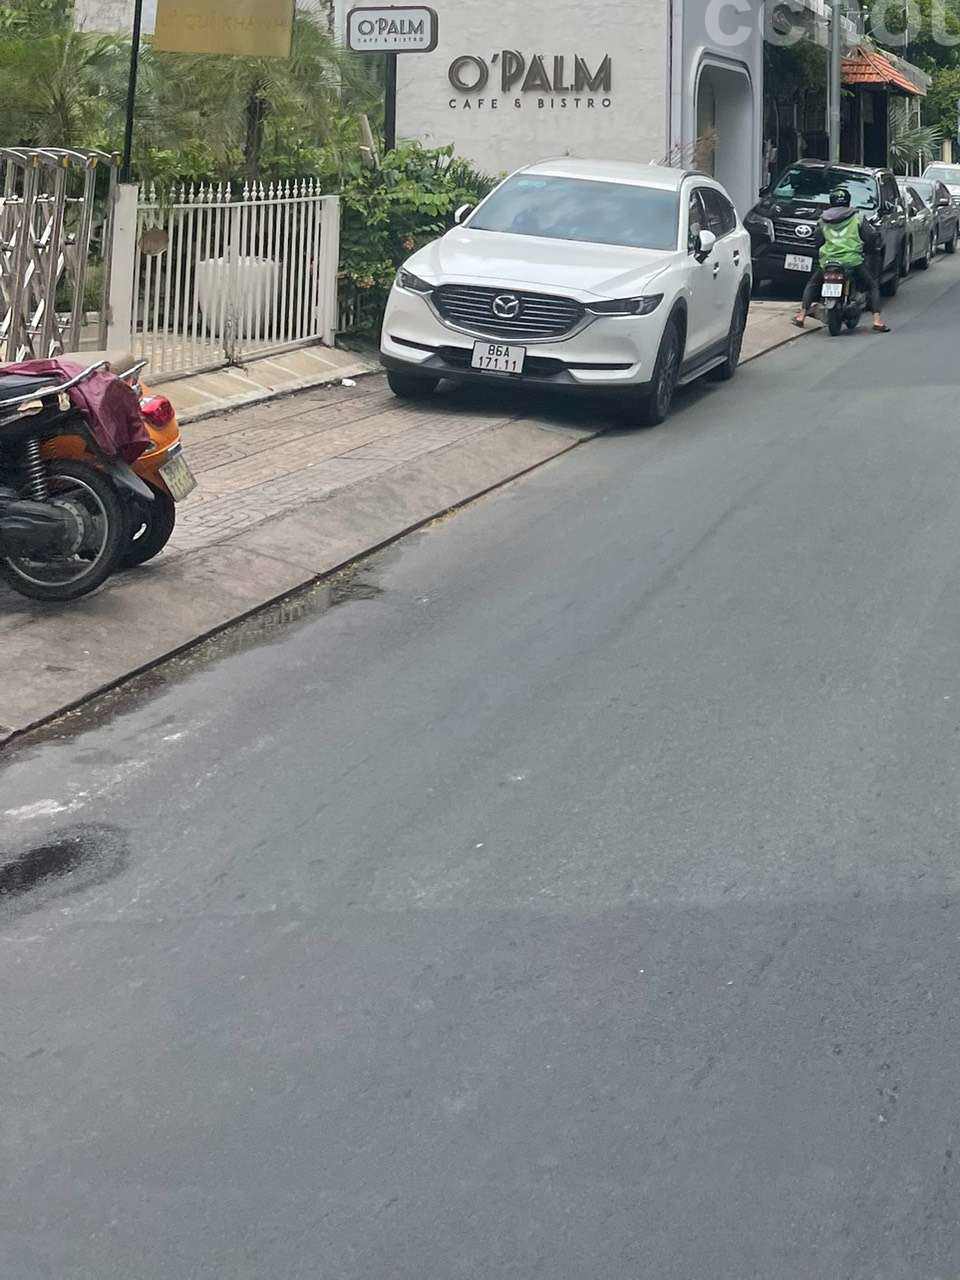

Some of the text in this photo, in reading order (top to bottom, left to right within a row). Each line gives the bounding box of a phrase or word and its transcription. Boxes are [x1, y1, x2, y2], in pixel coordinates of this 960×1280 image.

[357, 17, 424, 36] O'PALM
[448, 49, 612, 94] O'PALM
[448, 98, 612, 110] CAFE & BISTRO
[487, 344, 510, 358] 86A
[479, 355, 516, 371] 171.11
